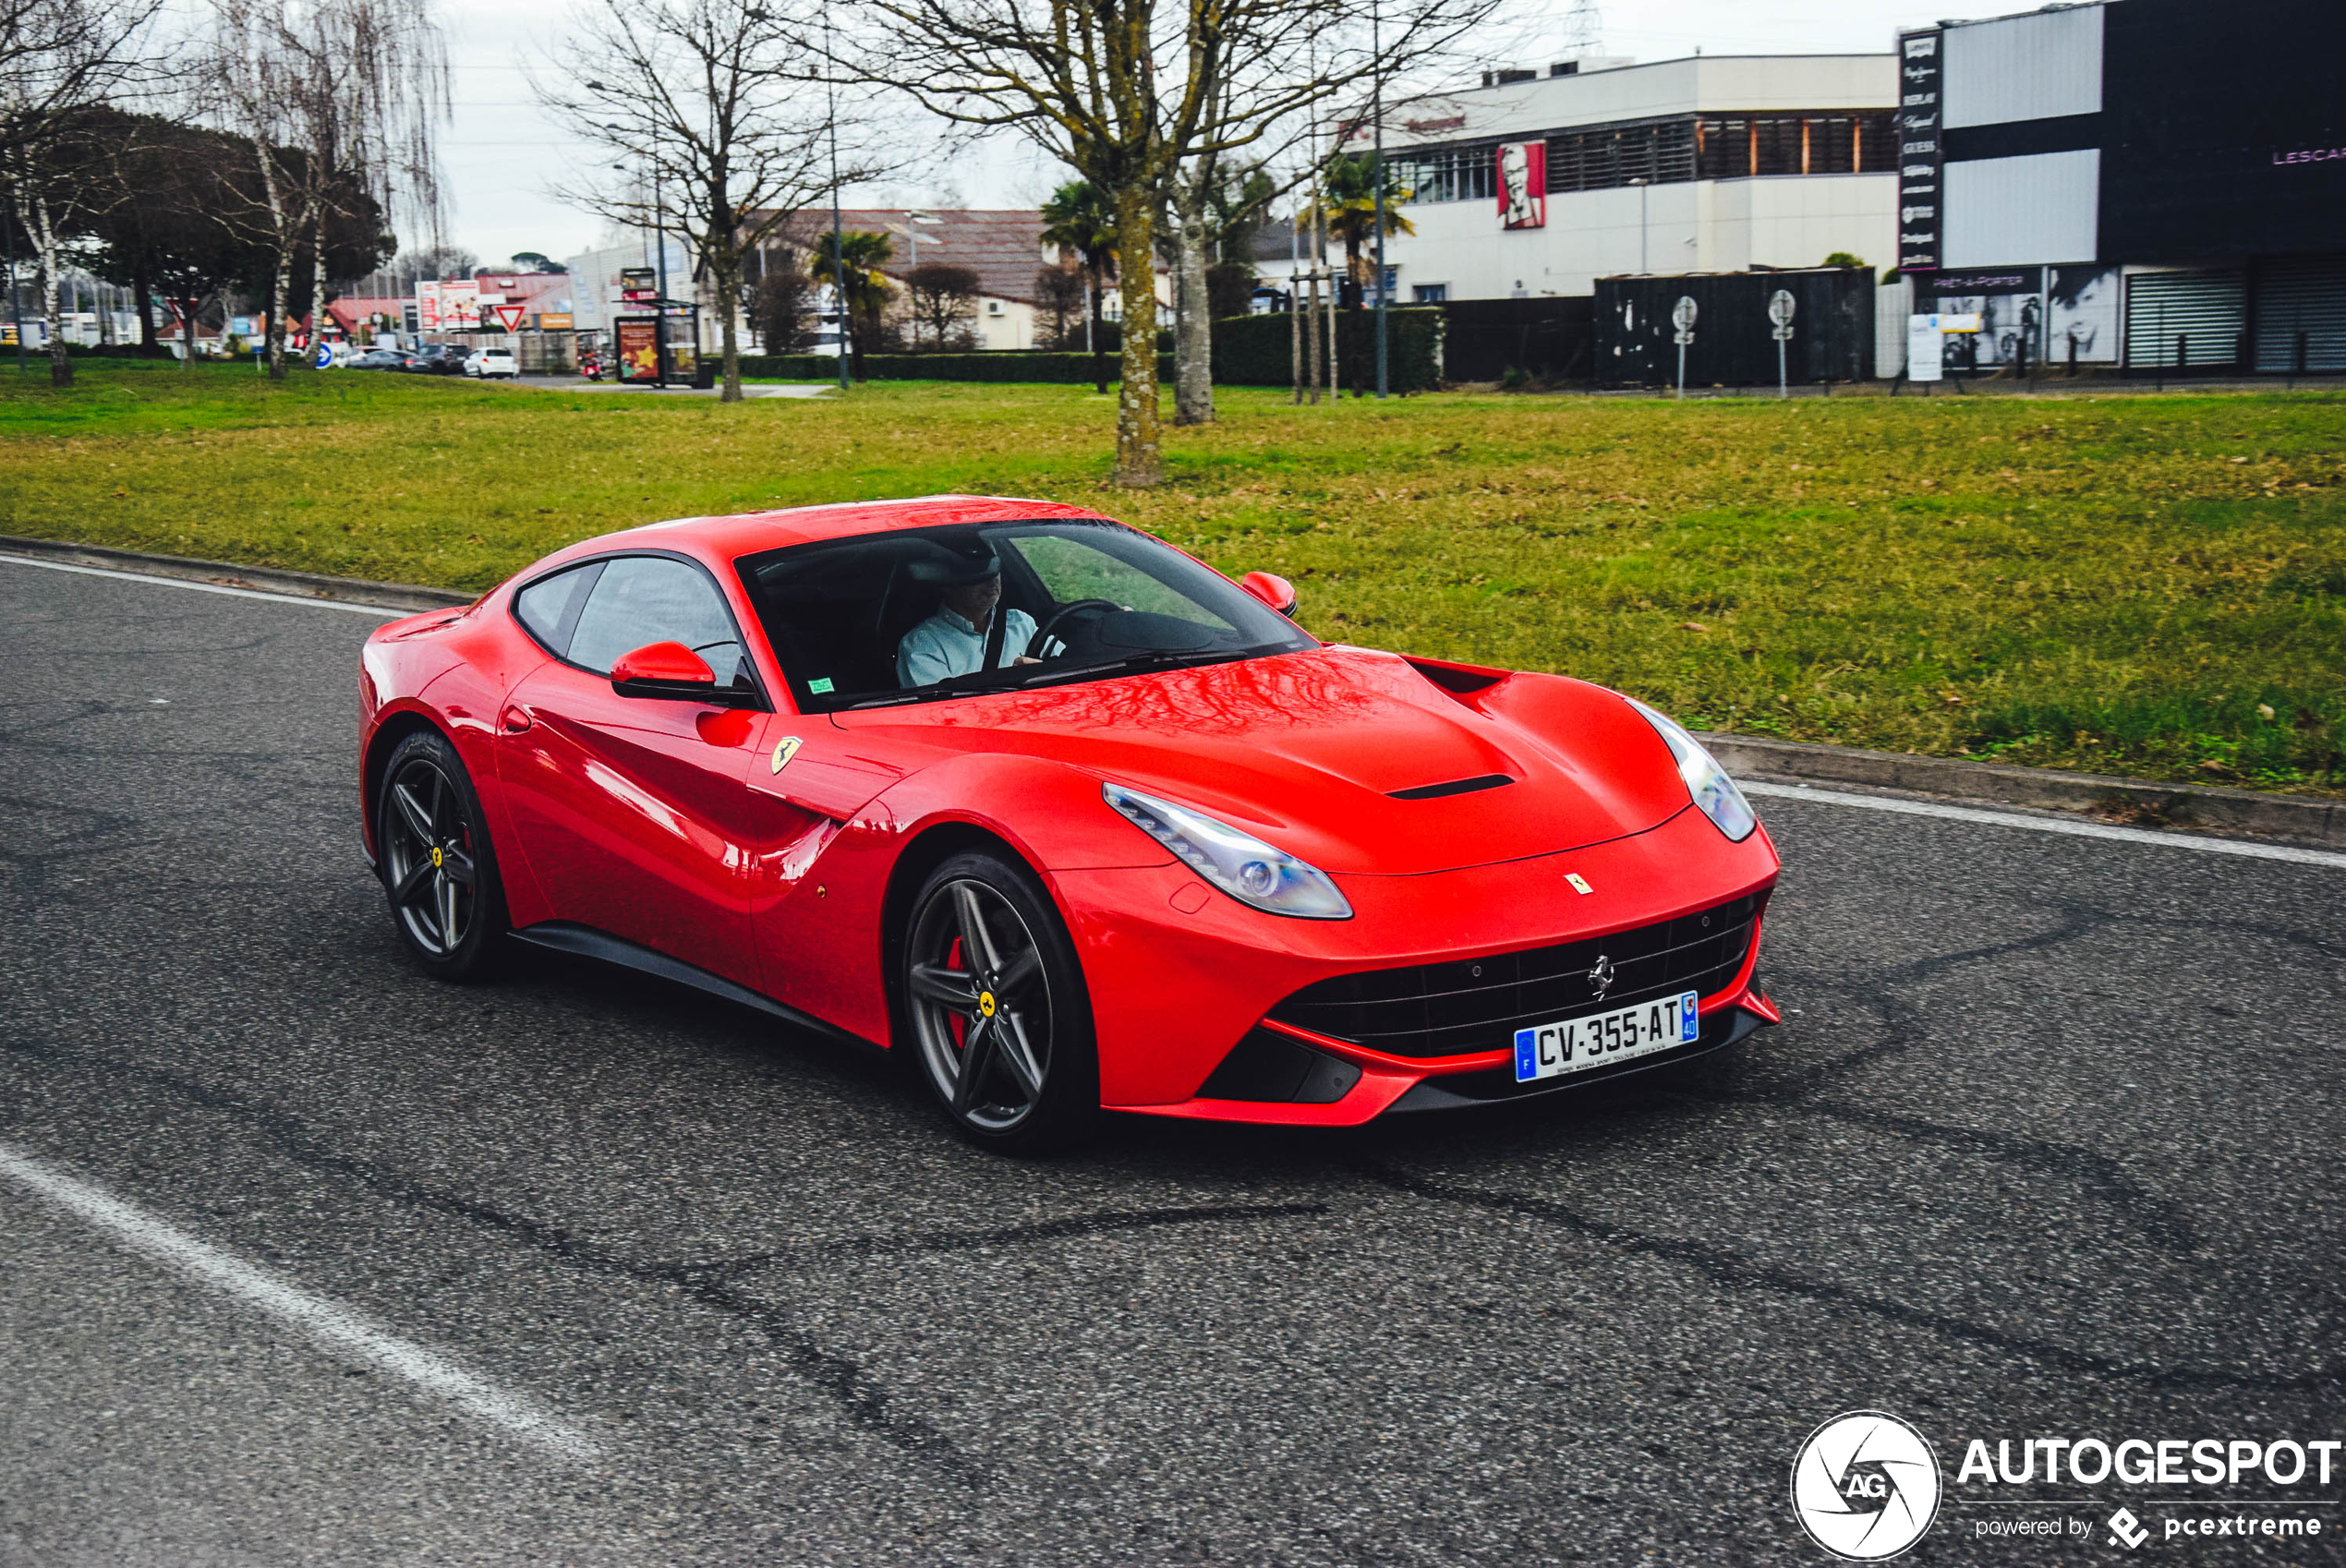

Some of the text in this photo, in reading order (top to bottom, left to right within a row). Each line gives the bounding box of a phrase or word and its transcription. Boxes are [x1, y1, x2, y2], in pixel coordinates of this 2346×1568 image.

[1540, 1001, 1677, 1066] CV-355-AT
[1684, 1020, 1695, 1036] 40
[1523, 1059, 1530, 1069] F
